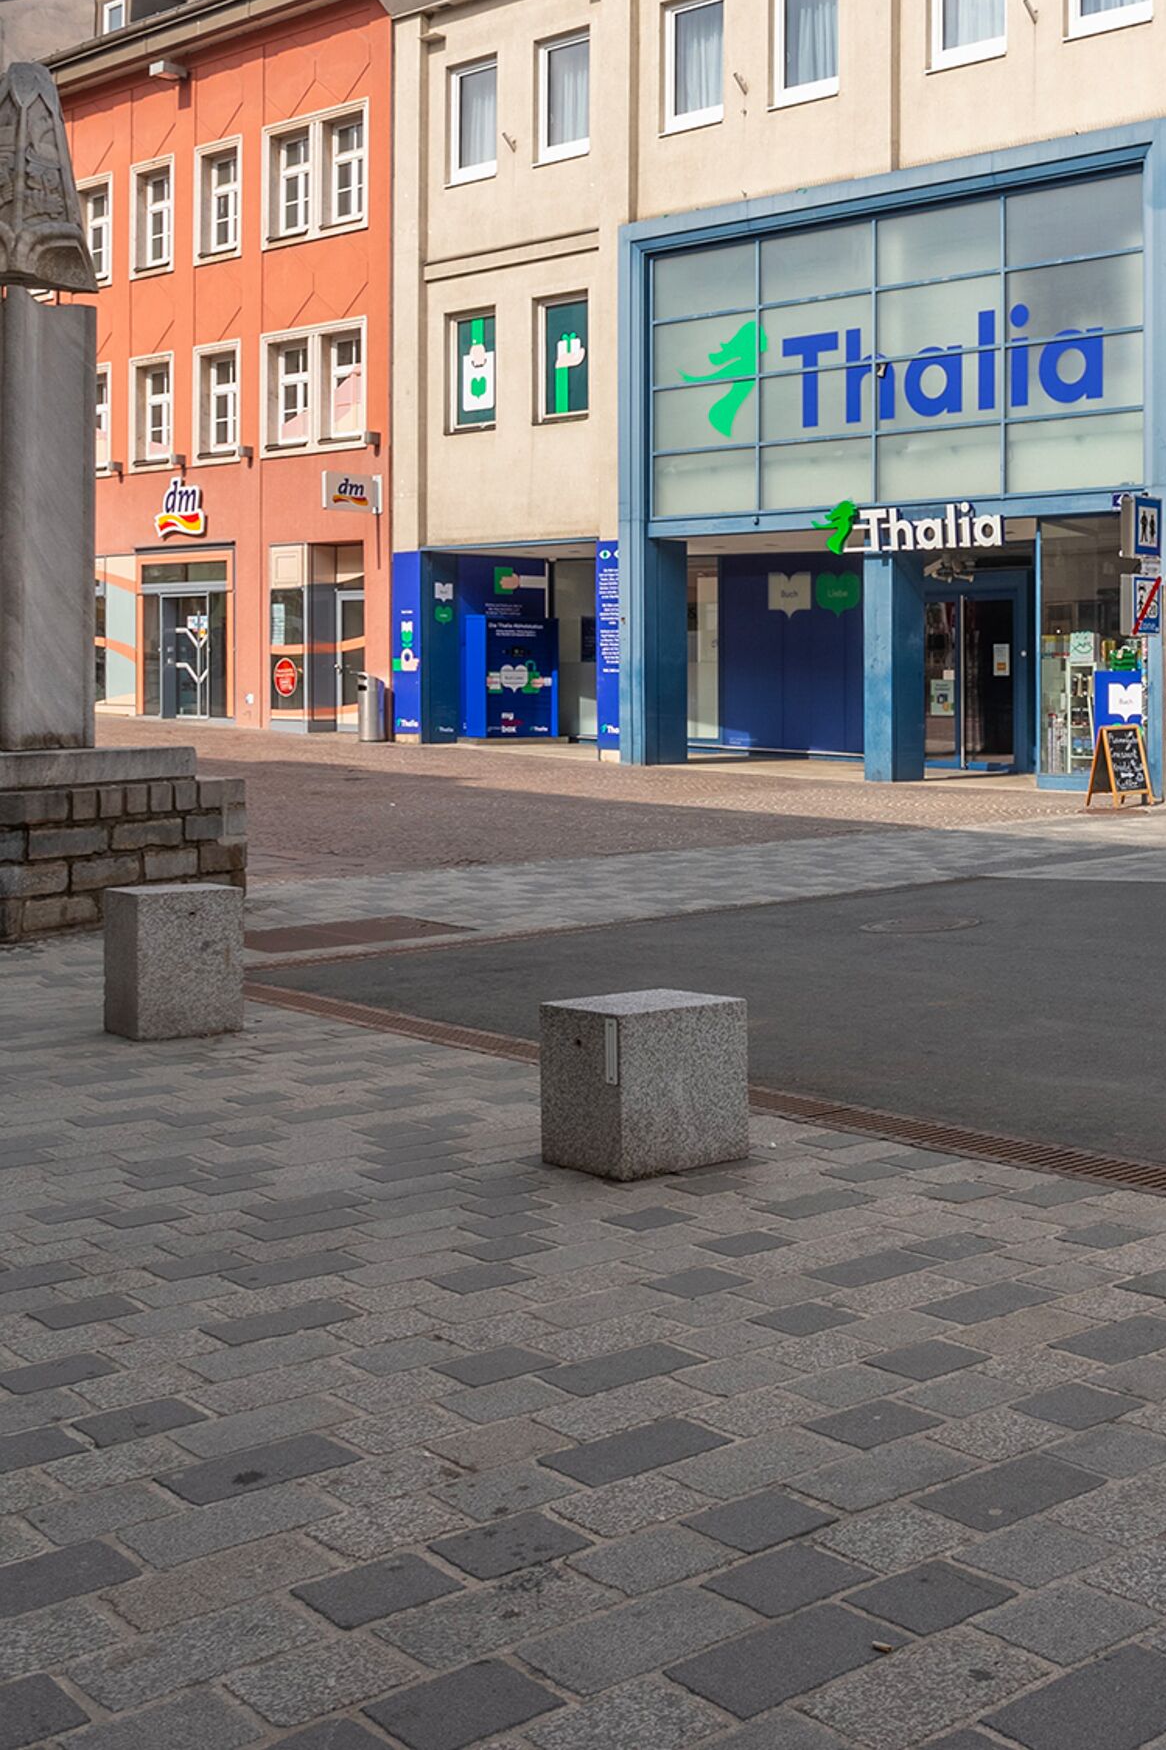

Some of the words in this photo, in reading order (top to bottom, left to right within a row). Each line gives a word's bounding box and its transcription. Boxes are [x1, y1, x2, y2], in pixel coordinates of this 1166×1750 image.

[782, 304, 1103, 428] Thalia
[165, 480, 197, 513] dm
[338, 478, 365, 497] dm
[860, 502, 1003, 551] Thalia
[781, 590, 798, 598] Buch
[827, 589, 848, 598] Liebe
